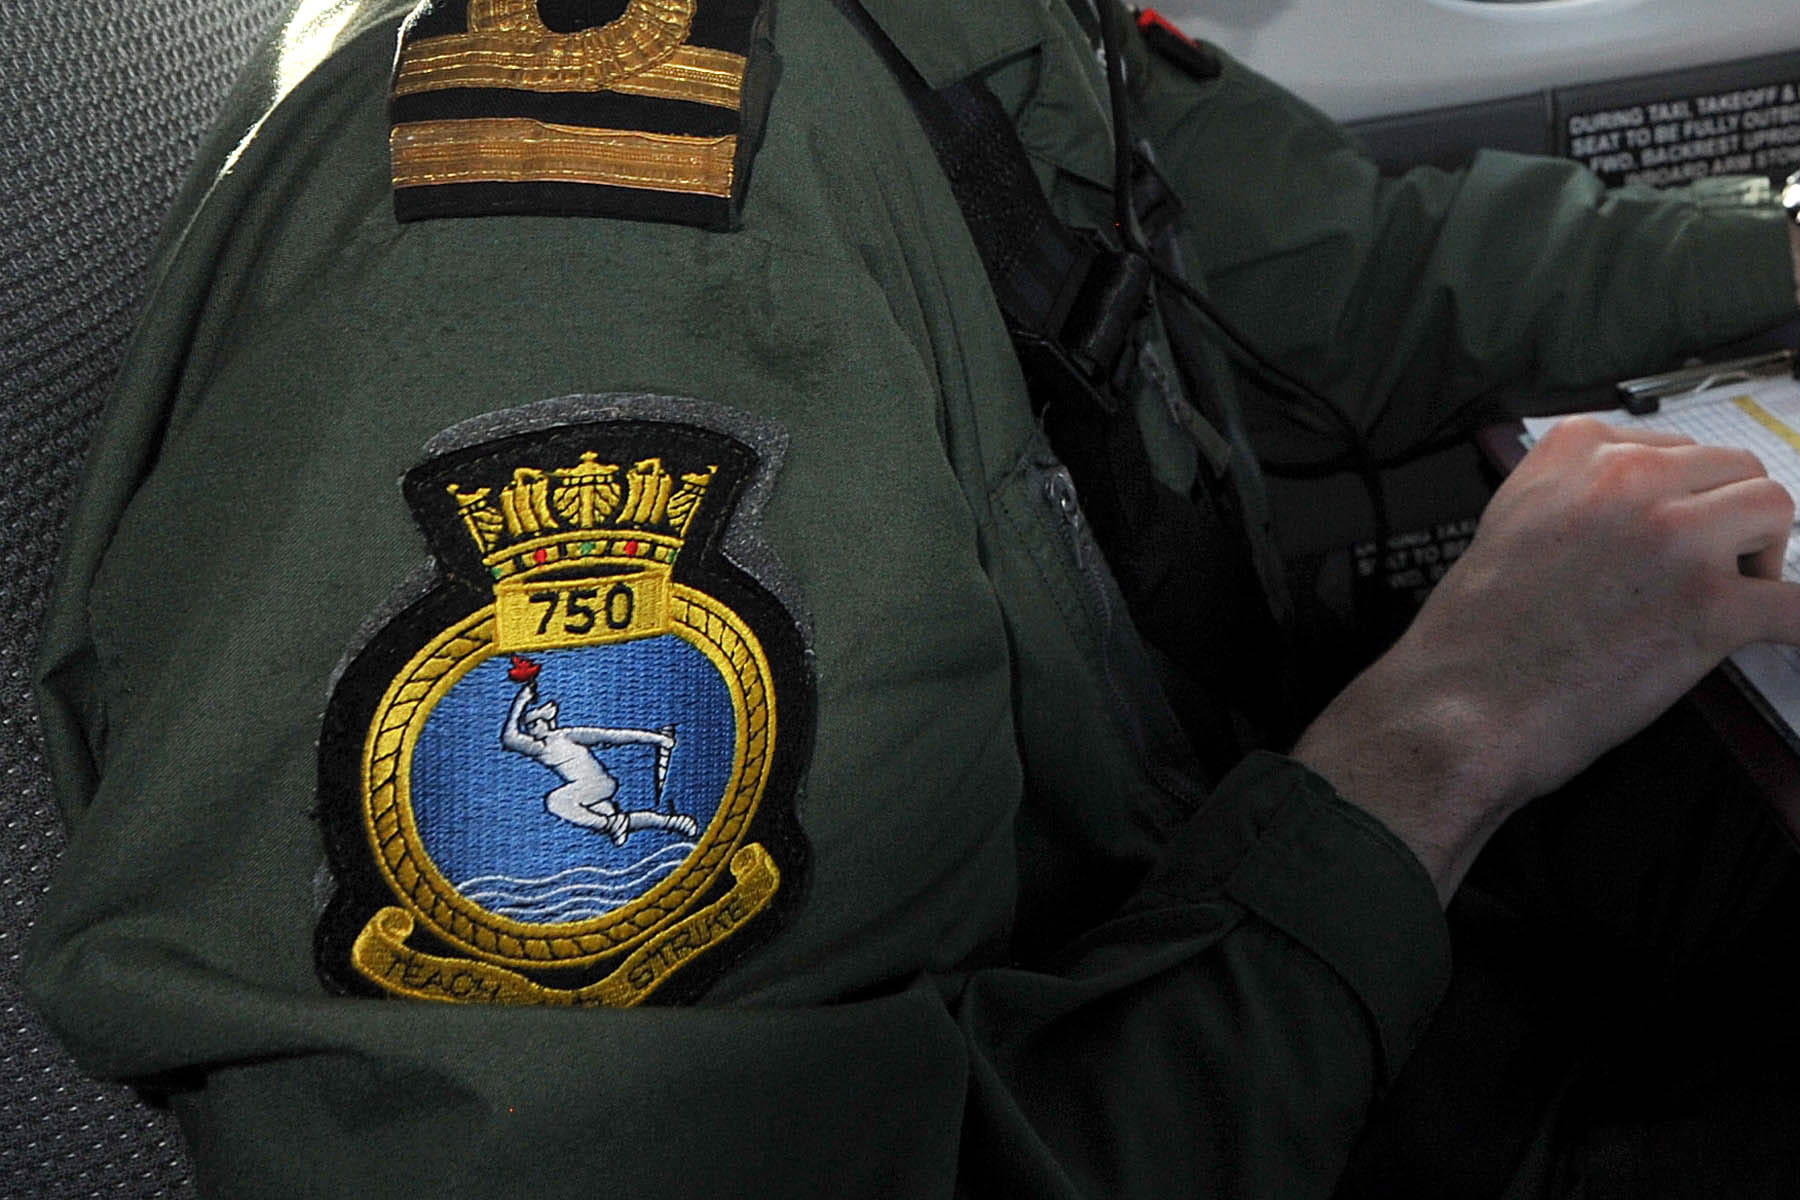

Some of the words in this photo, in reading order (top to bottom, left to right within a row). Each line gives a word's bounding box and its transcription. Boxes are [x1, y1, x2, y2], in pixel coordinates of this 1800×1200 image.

[1625, 126, 1652, 148] TO
[1681, 113, 1740, 139] FULLY
[528, 582, 636, 636] 750
